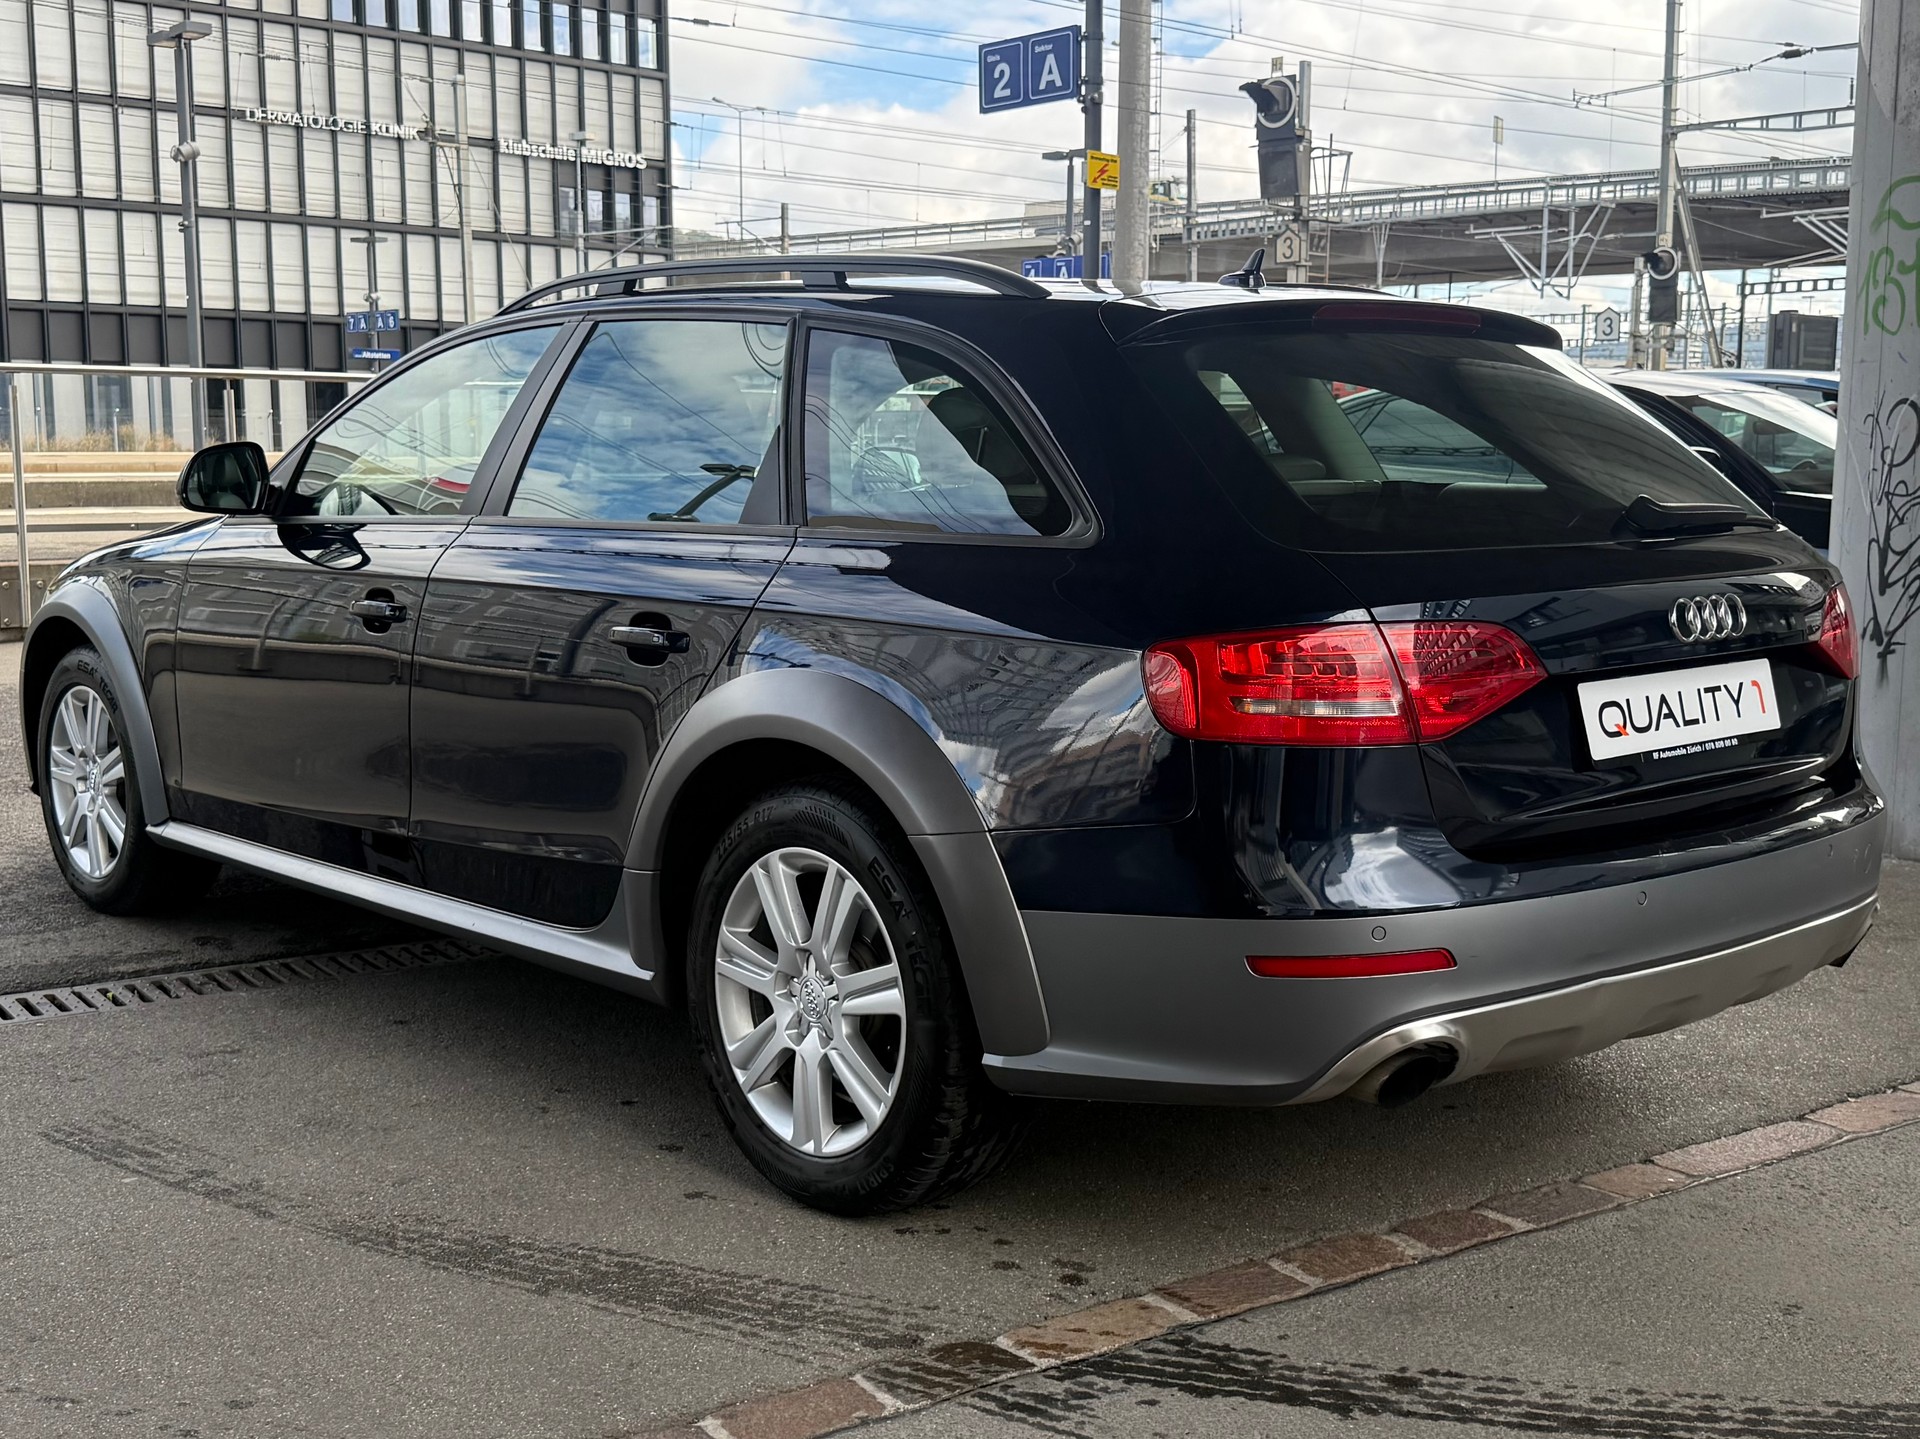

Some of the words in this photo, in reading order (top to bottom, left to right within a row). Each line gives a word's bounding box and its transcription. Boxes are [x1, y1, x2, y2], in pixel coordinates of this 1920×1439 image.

[993, 62, 1011, 99] 2
[1039, 53, 1063, 90] A
[245, 107, 368, 134] DERMATOLOGIE
[371, 122, 420, 141] KLINIK
[499, 138, 576, 162] klubschule
[581, 146, 648, 170] MIGROS
[1282, 236, 1294, 260] 3
[349, 318, 354, 330] 7
[360, 318, 366, 329] A
[378, 317, 384, 328] A
[389, 315, 395, 328] 6
[1602, 316, 1613, 337] 3
[1598, 681, 1744, 739] QUALITY
[1751, 679, 1766, 714] 1
[1660, 746, 1687, 759] Automobile
[1687, 745, 1702, 754] Zürich
